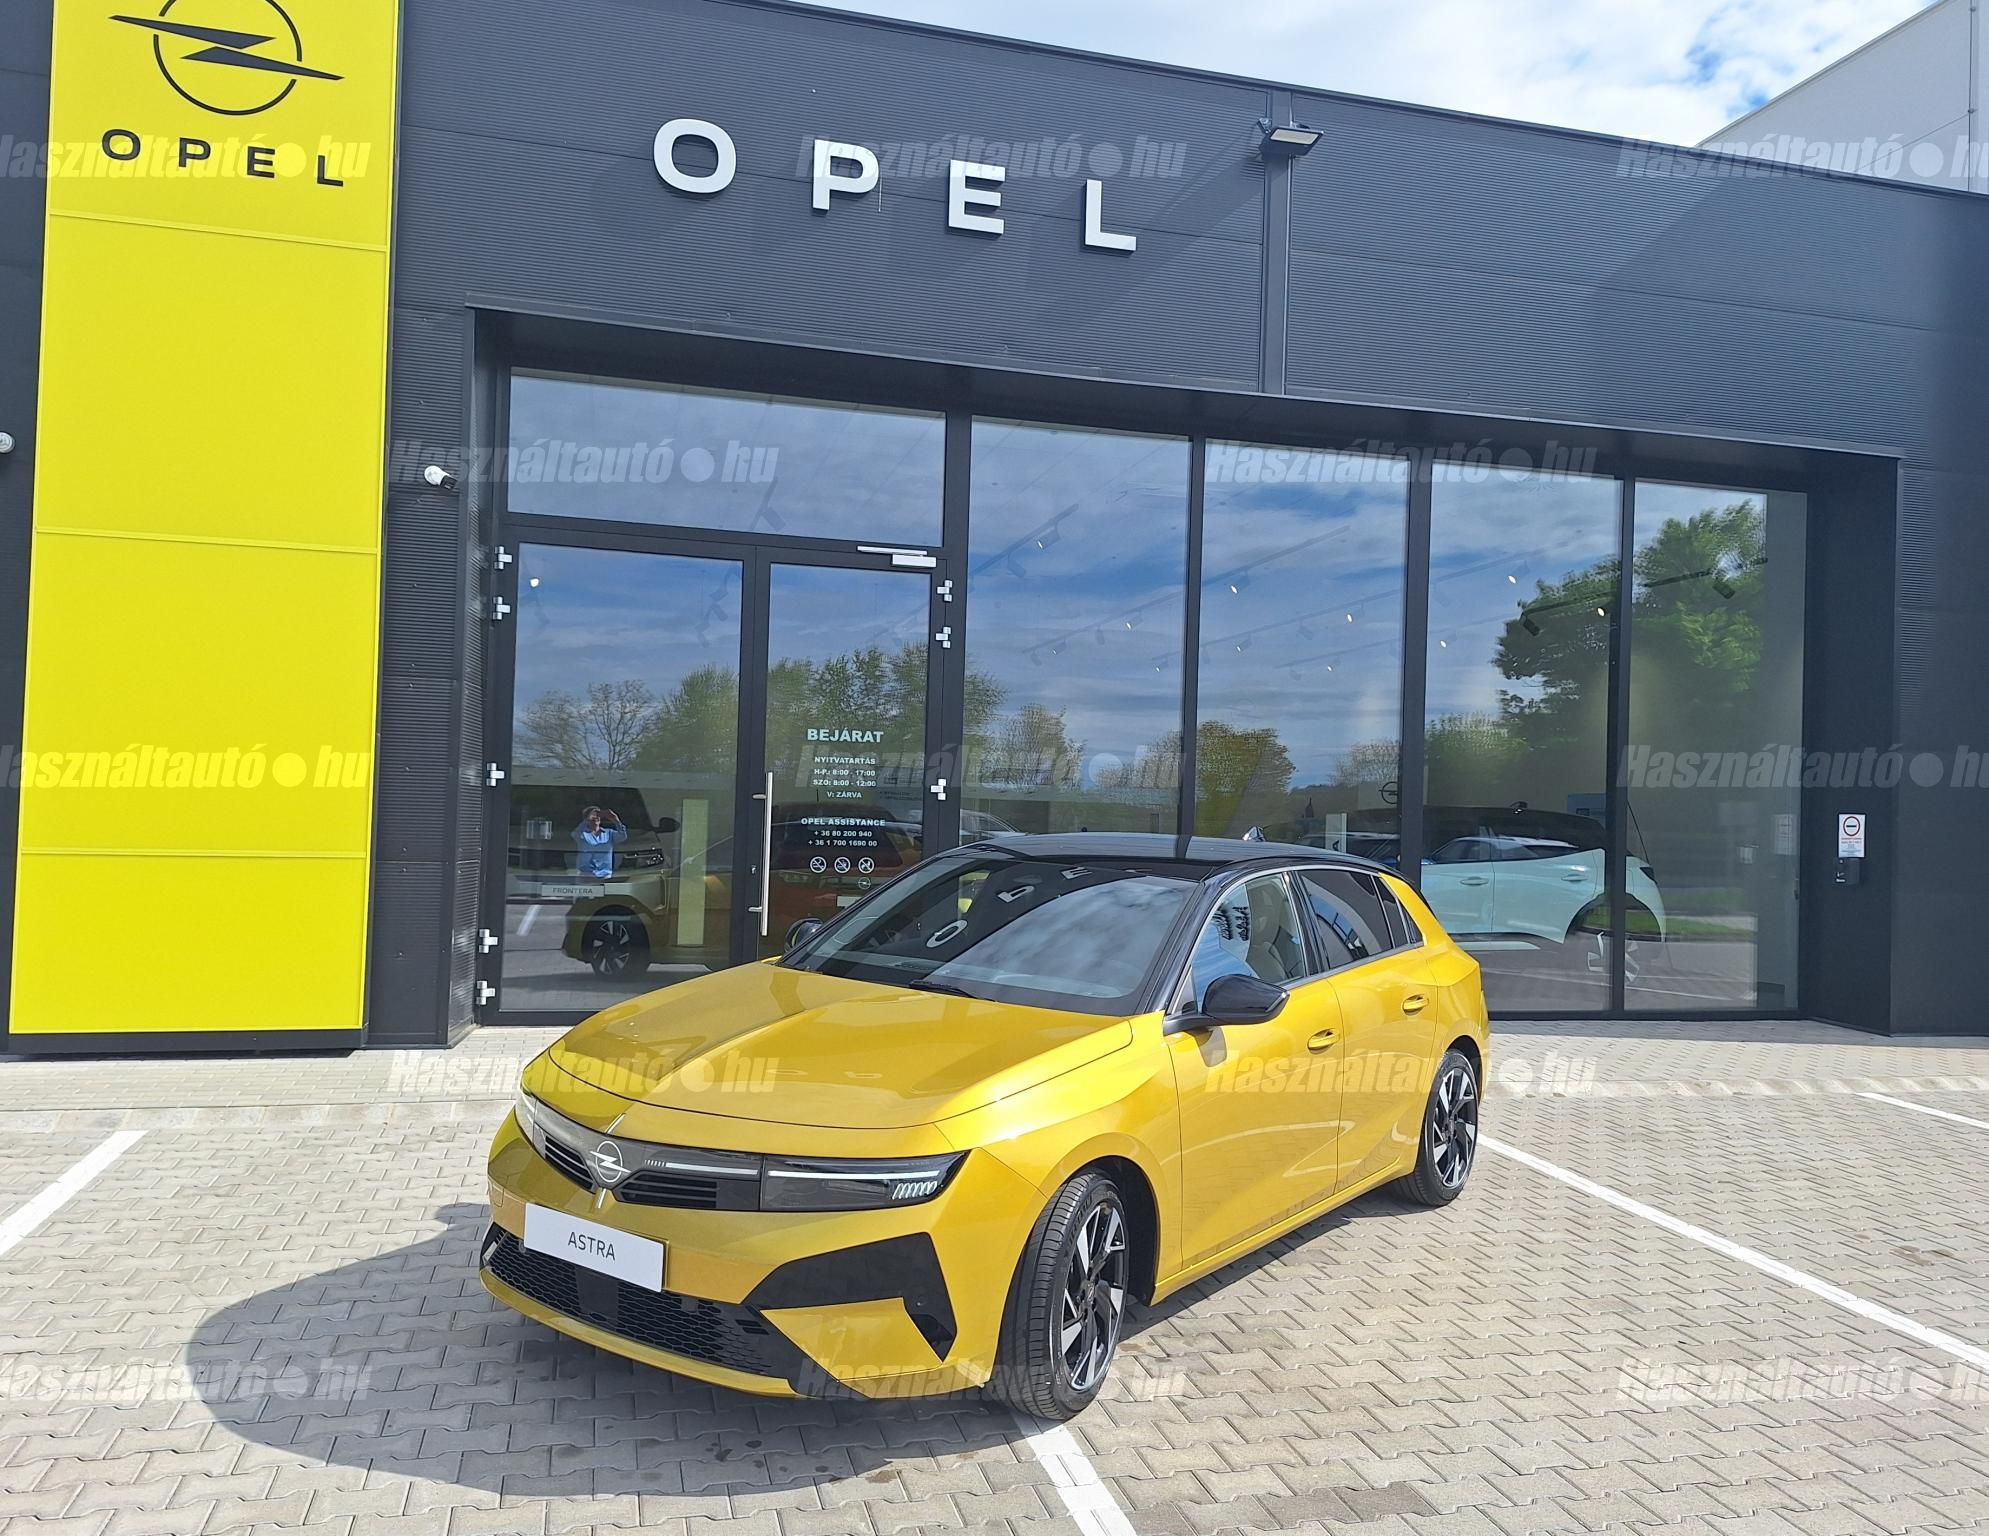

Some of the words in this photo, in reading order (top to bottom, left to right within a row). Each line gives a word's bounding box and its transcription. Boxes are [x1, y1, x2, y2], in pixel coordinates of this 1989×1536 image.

[101, 128, 344, 187] OPEL
[653, 118, 1137, 252] OPEL
[807, 727, 884, 743] BEJÁRAT
[814, 756, 876, 765] NYITVATARTÁS
[856, 769, 876, 777] 17:00
[836, 790, 862, 798] ZÁRVA
[828, 818, 886, 827] ASSISTANCE
[552, 887, 593, 895] FRONTERA
[567, 1231, 616, 1261] ASTRA
